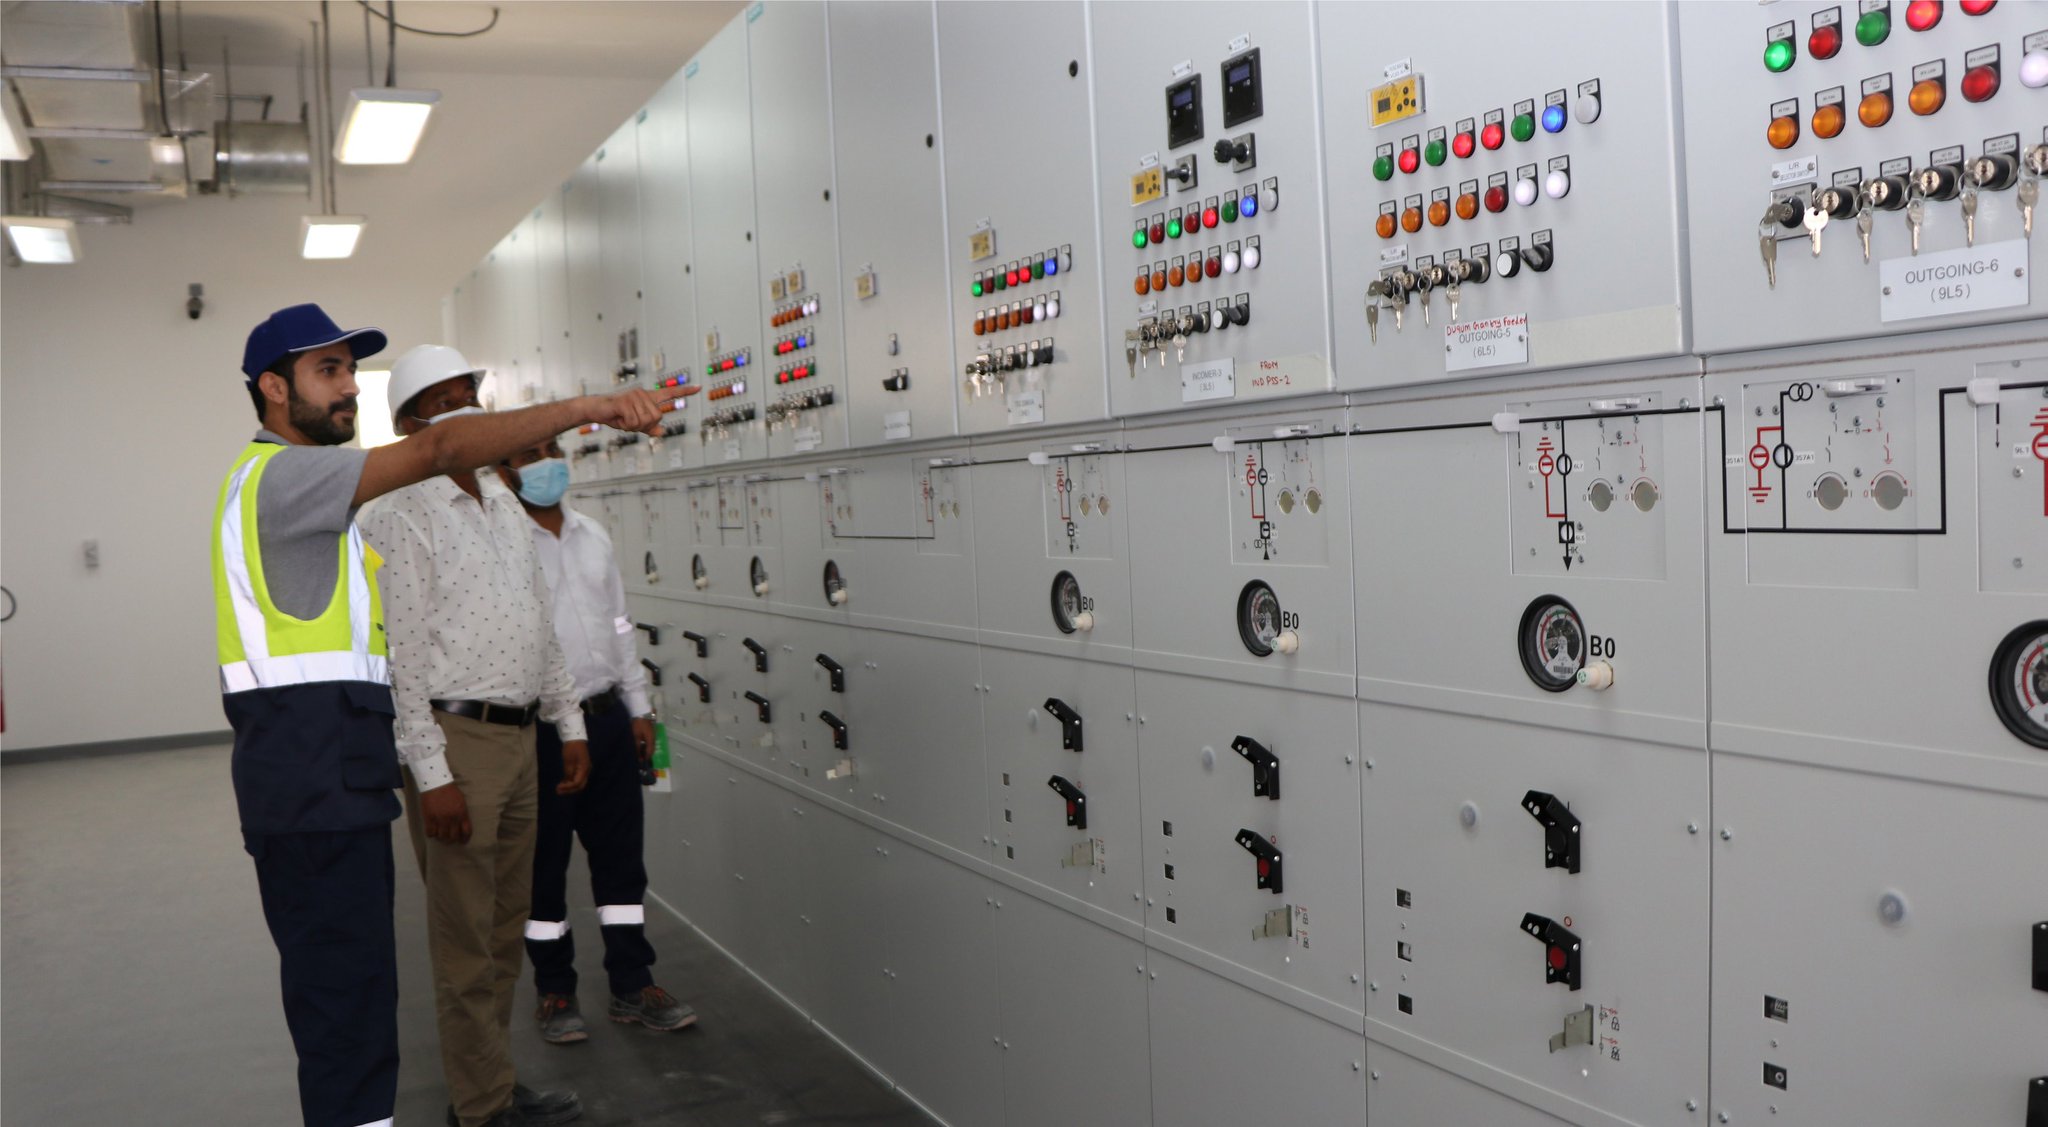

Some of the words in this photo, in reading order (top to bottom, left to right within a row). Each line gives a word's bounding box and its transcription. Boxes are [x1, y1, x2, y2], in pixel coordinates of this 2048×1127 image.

[1905, 258, 1999, 284] OUTGOING-6
[1459, 327, 1511, 344] OUTGOING-5
[1260, 361, 1279, 370] FROM
[1192, 368, 1222, 381] INCOMER-3
